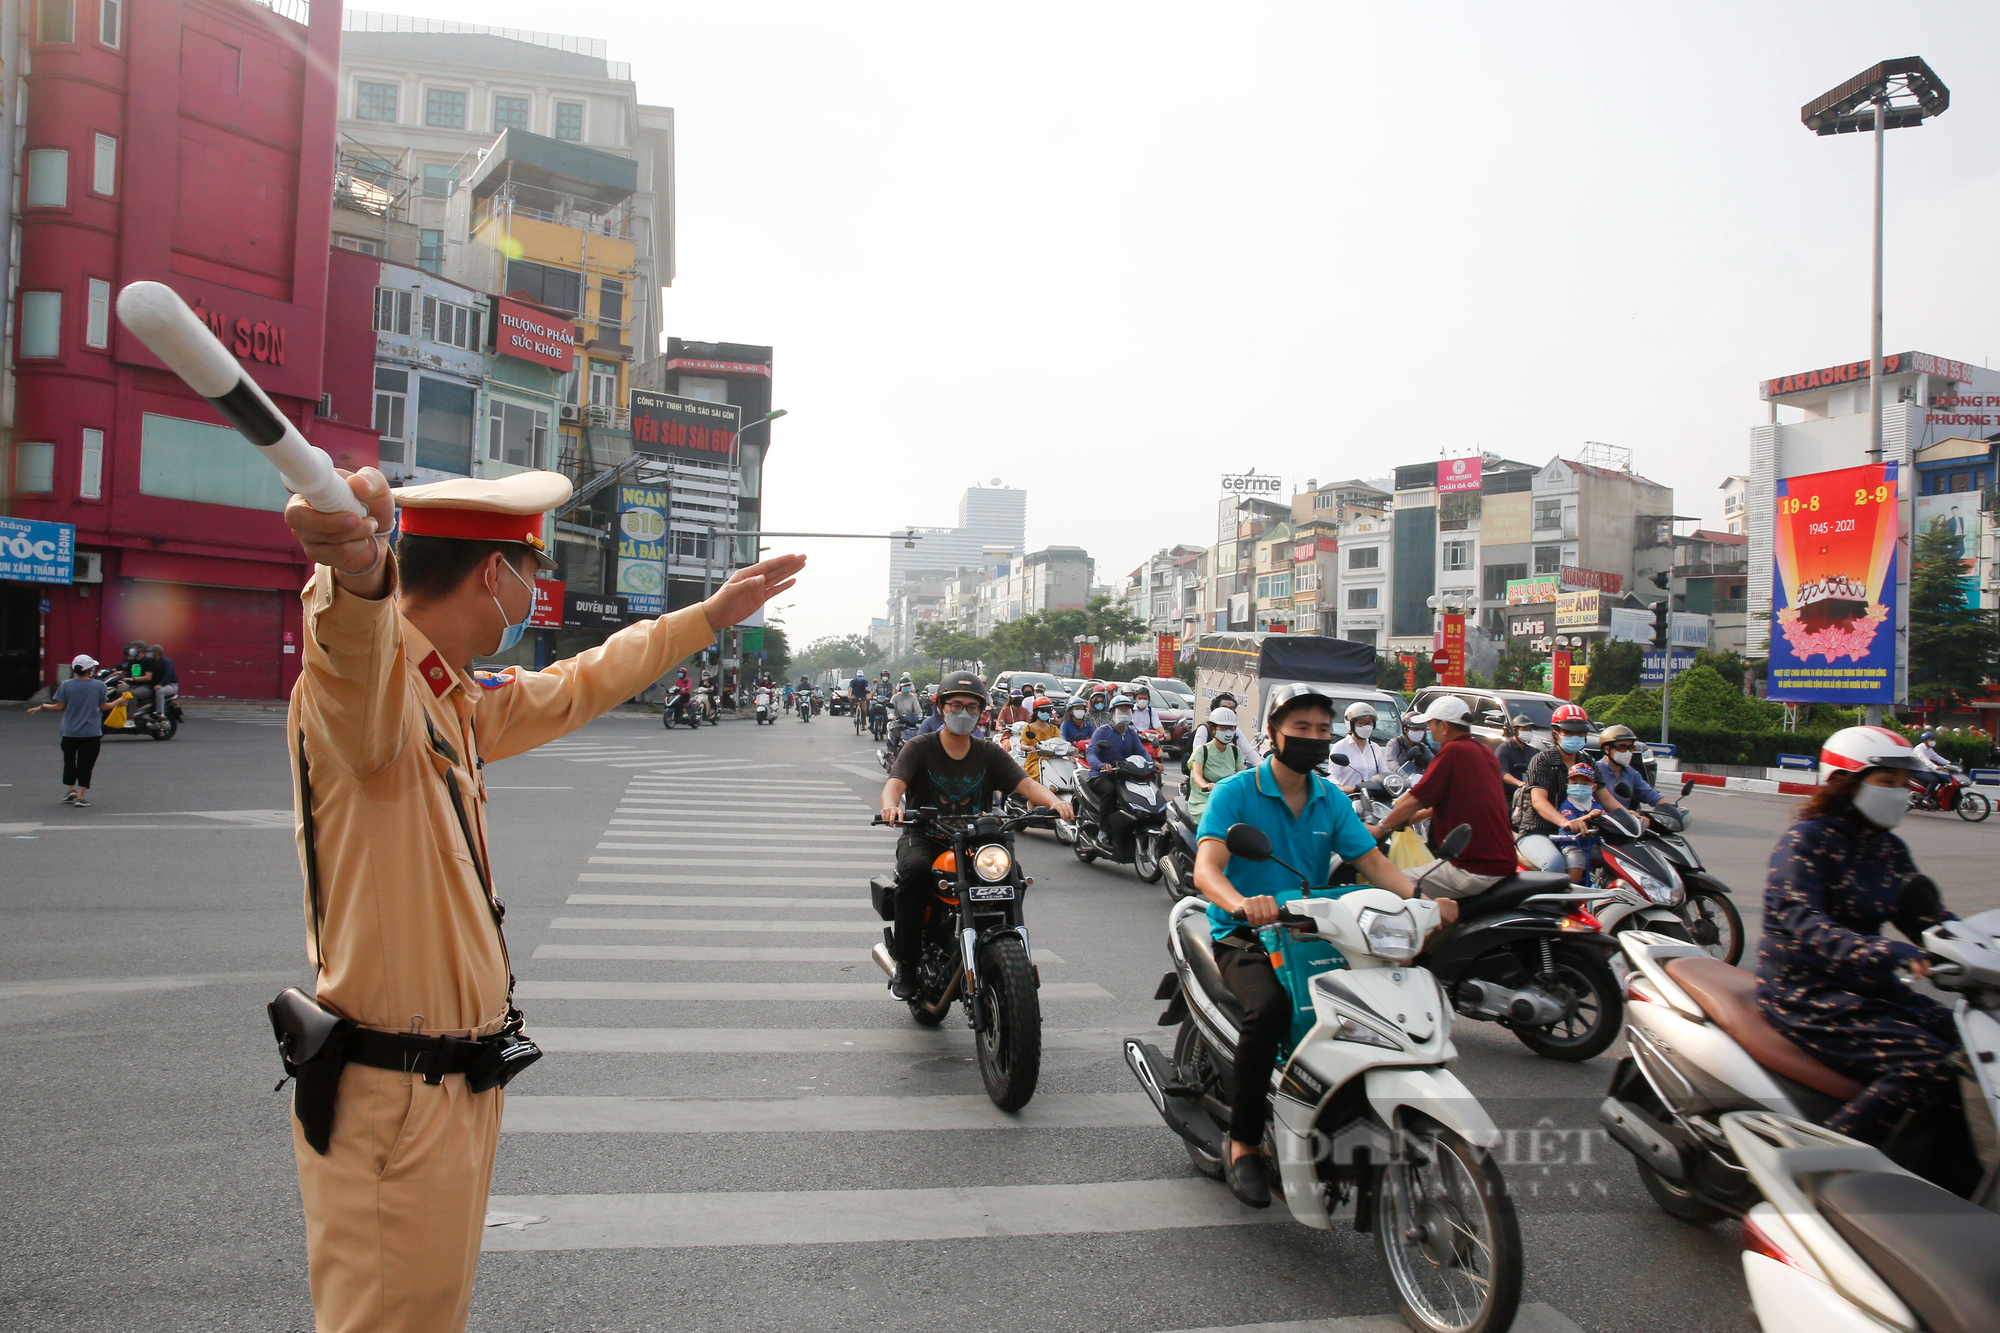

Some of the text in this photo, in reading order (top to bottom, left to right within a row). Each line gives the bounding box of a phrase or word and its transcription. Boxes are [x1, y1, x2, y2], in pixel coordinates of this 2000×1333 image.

[501, 313, 575, 347] THƯỢNG PHẨM
[234, 317, 286, 366] SƠN
[511, 333, 533, 350] SỨC
[1914, 353, 1935, 374] 0988
[1936, 357, 1948, 377] 59
[1950, 361, 1961, 379] 55
[1768, 365, 1859, 396] KARAOKE
[637, 396, 735, 420] CÔNG TY TNHH YẾN SÀO SÀI GÒN
[1936, 390, 1983, 407] ĐỒNG
[1925, 412, 1991, 426] PHƯƠNG
[633, 408, 659, 444] YẾN
[661, 418, 687, 448] SÀO
[688, 422, 710, 451] SÀI
[622, 488, 668, 508] NGAN
[0, 521, 32, 532] háng
[628, 512, 662, 535] 516
[1808, 522, 1829, 535] 1945
[1835, 519, 1855, 532] 2021
[618, 539, 667, 560] XÃ ĐÀN
[0, 562, 11, 572] UN
[1508, 578, 1556, 597] RAU CỦ QUẢ
[1600, 572, 1622, 594] LED
[576, 600, 618, 615] DUYÊN BÙI
[1556, 592, 1598, 612] CHỤP ẢNH
[1447, 624, 1462, 634] 19-8
[1512, 618, 1545, 636] QUẢNG
[1683, 625, 1707, 644] NHANH
[1661, 656, 1678, 670] HNG
[976, 887, 1008, 896] GPX
